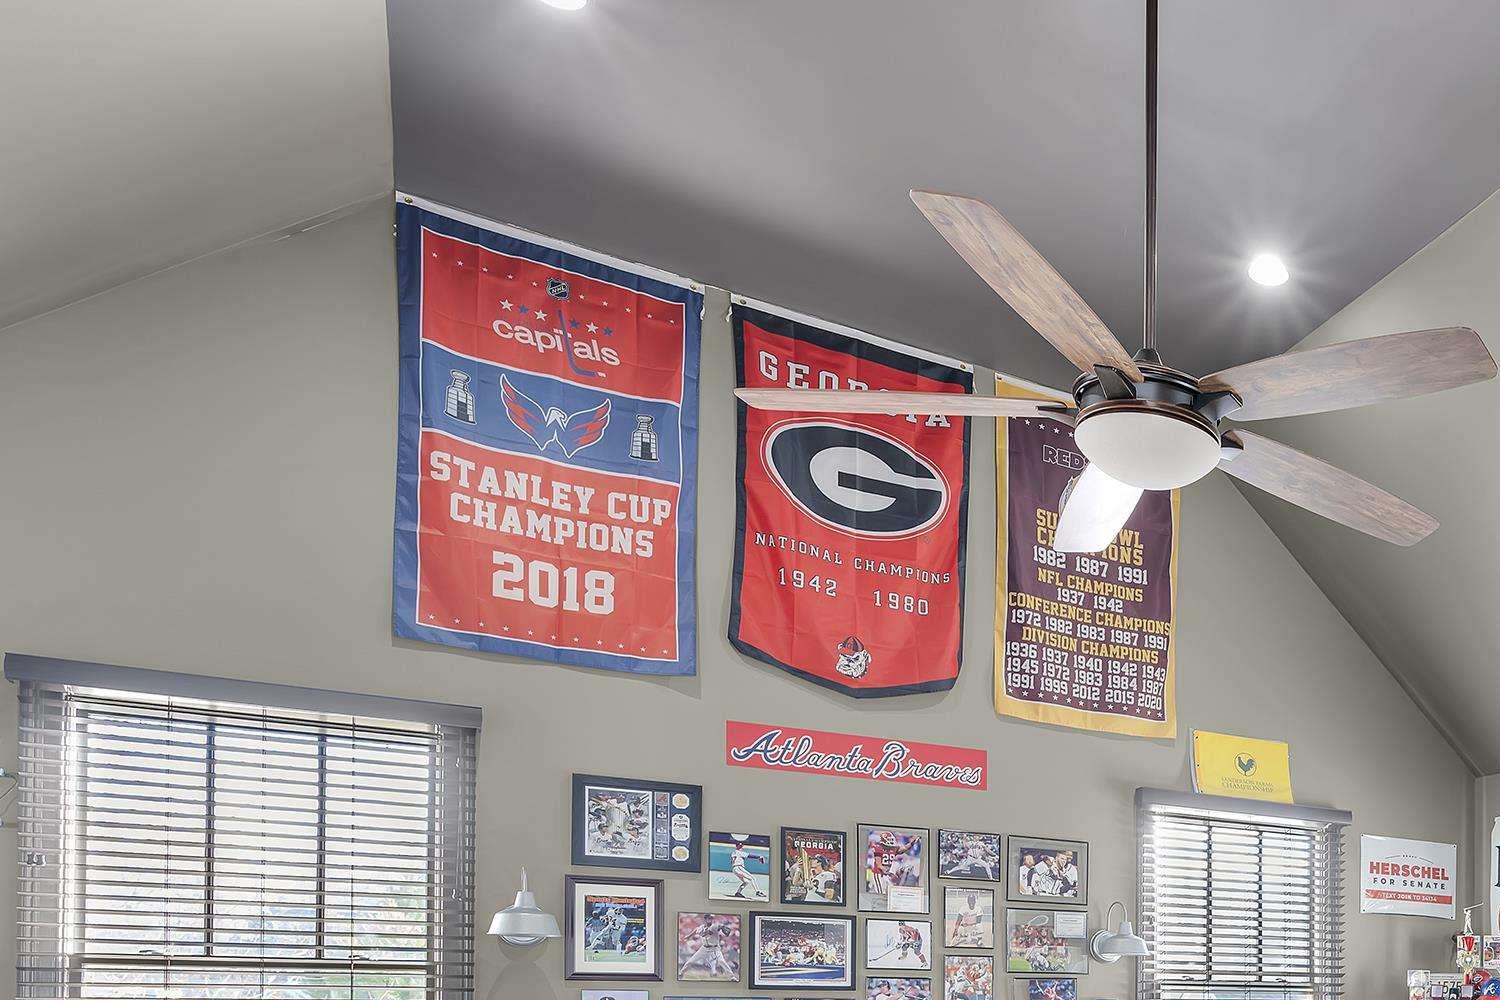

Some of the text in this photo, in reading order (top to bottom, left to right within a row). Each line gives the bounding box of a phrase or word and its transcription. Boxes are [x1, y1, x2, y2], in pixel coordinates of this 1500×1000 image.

[1043, 444, 1087, 470] RED
[430, 450, 672, 526] STANLEY CUP
[449, 492, 654, 558] CHAMPIONS
[755, 532, 951, 585] NATIONAL CHAMPIONS
[1033, 546, 1148, 586] 1982 1987 1991
[491, 550, 615, 615] 2018
[778, 568, 929, 616] 1942 1980
[1038, 568, 1143, 603] NFL CHAMPIONS
[1057, 588, 1123, 613] 1937 1942
[1008, 592, 1171, 636] CONFERENCE CHAMPIONS
[1011, 609, 1168, 650] 1972 1982 1983 1987 1991
[1006, 641, 1166, 681] 1936 1937 1940 1942 1943
[1022, 626, 1159, 665] DIVISION CHAMPIONS
[1006, 658, 1164, 695] 1945 1972 1983 1984 1987
[1007, 673, 1162, 710] 1991 1999 2012 2015 2020
[730, 729, 982, 786] Atlanta Braves
[794, 840, 834, 850] GEORGIA
[1369, 861, 1449, 881] HERSCHEL
[1373, 877, 1446, 890] FOR SENATE
